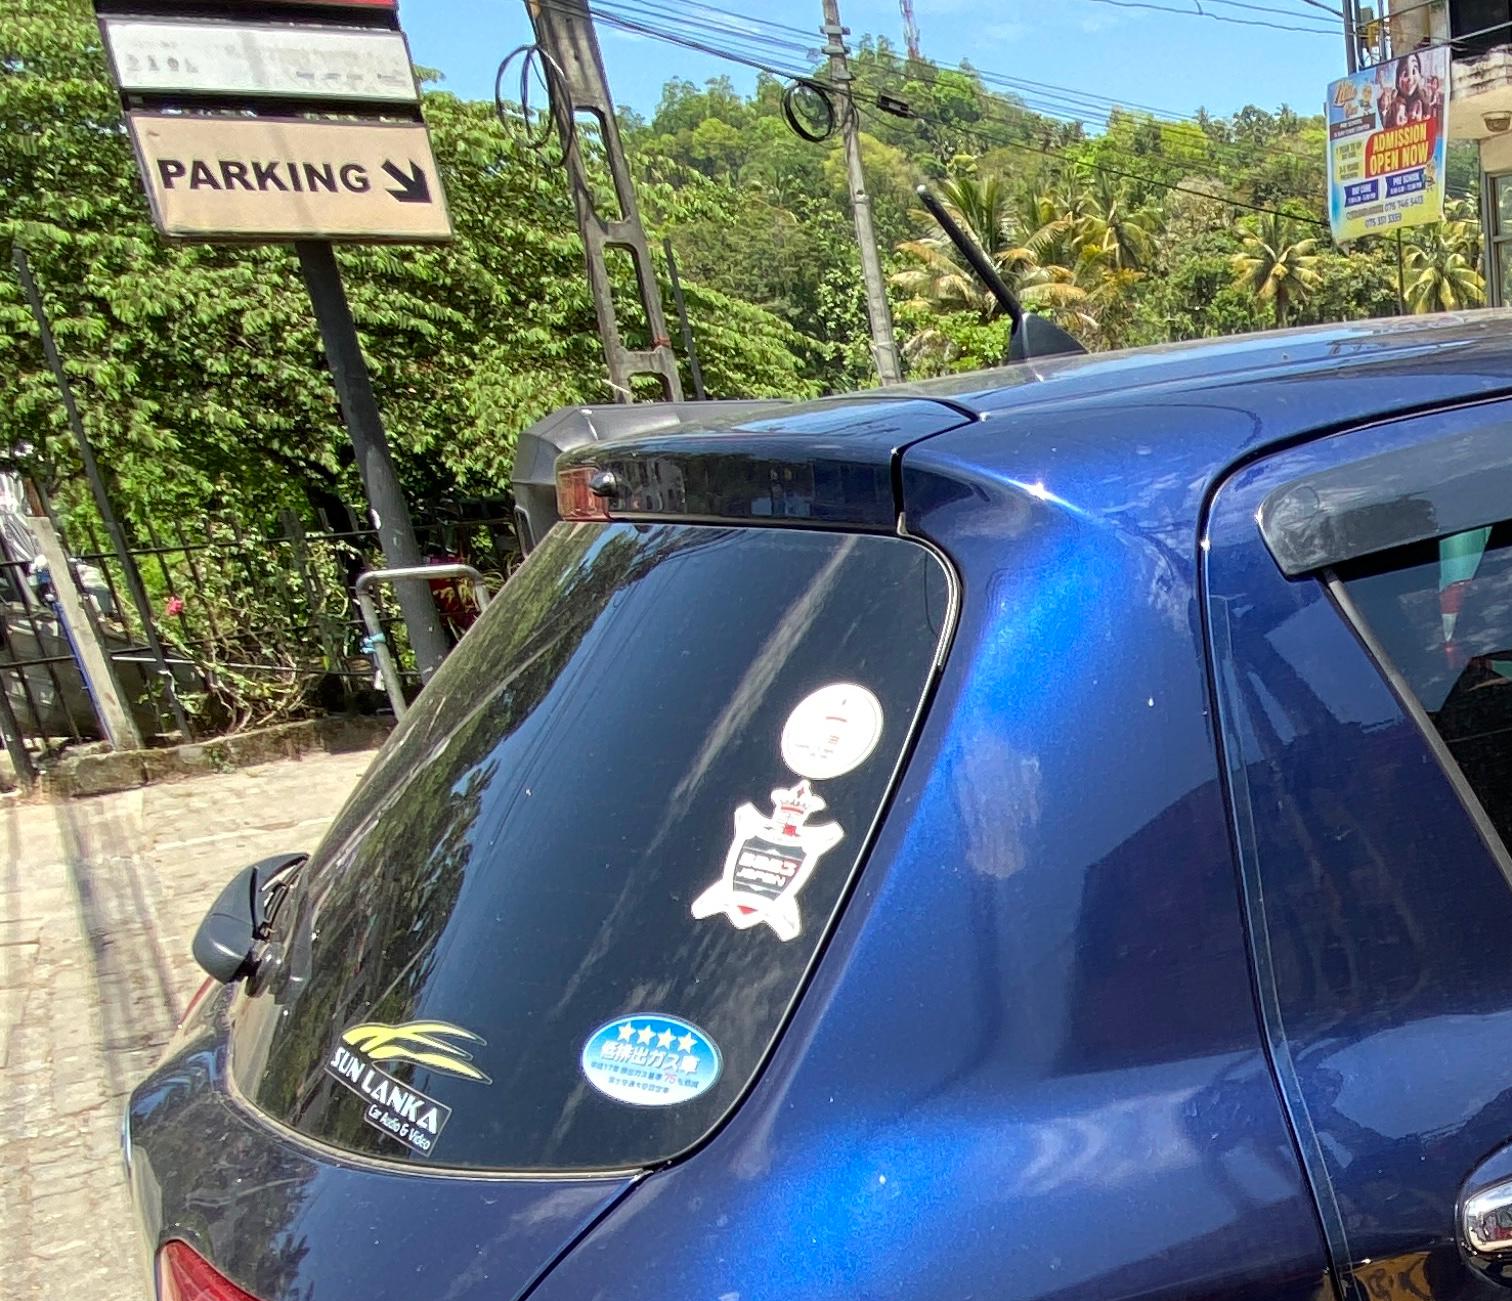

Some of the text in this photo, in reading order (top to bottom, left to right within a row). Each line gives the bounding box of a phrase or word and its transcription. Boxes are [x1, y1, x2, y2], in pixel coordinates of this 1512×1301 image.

[1373, 123, 1427, 152] ADMISSION
[157, 158, 372, 194] PARKING
[1369, 150, 1399, 176] OPEN
[1401, 141, 1429, 168] NOW
[331, 1047, 438, 1134] SUN LANKA
[368, 1104, 431, 1151] Car Audio & Video
